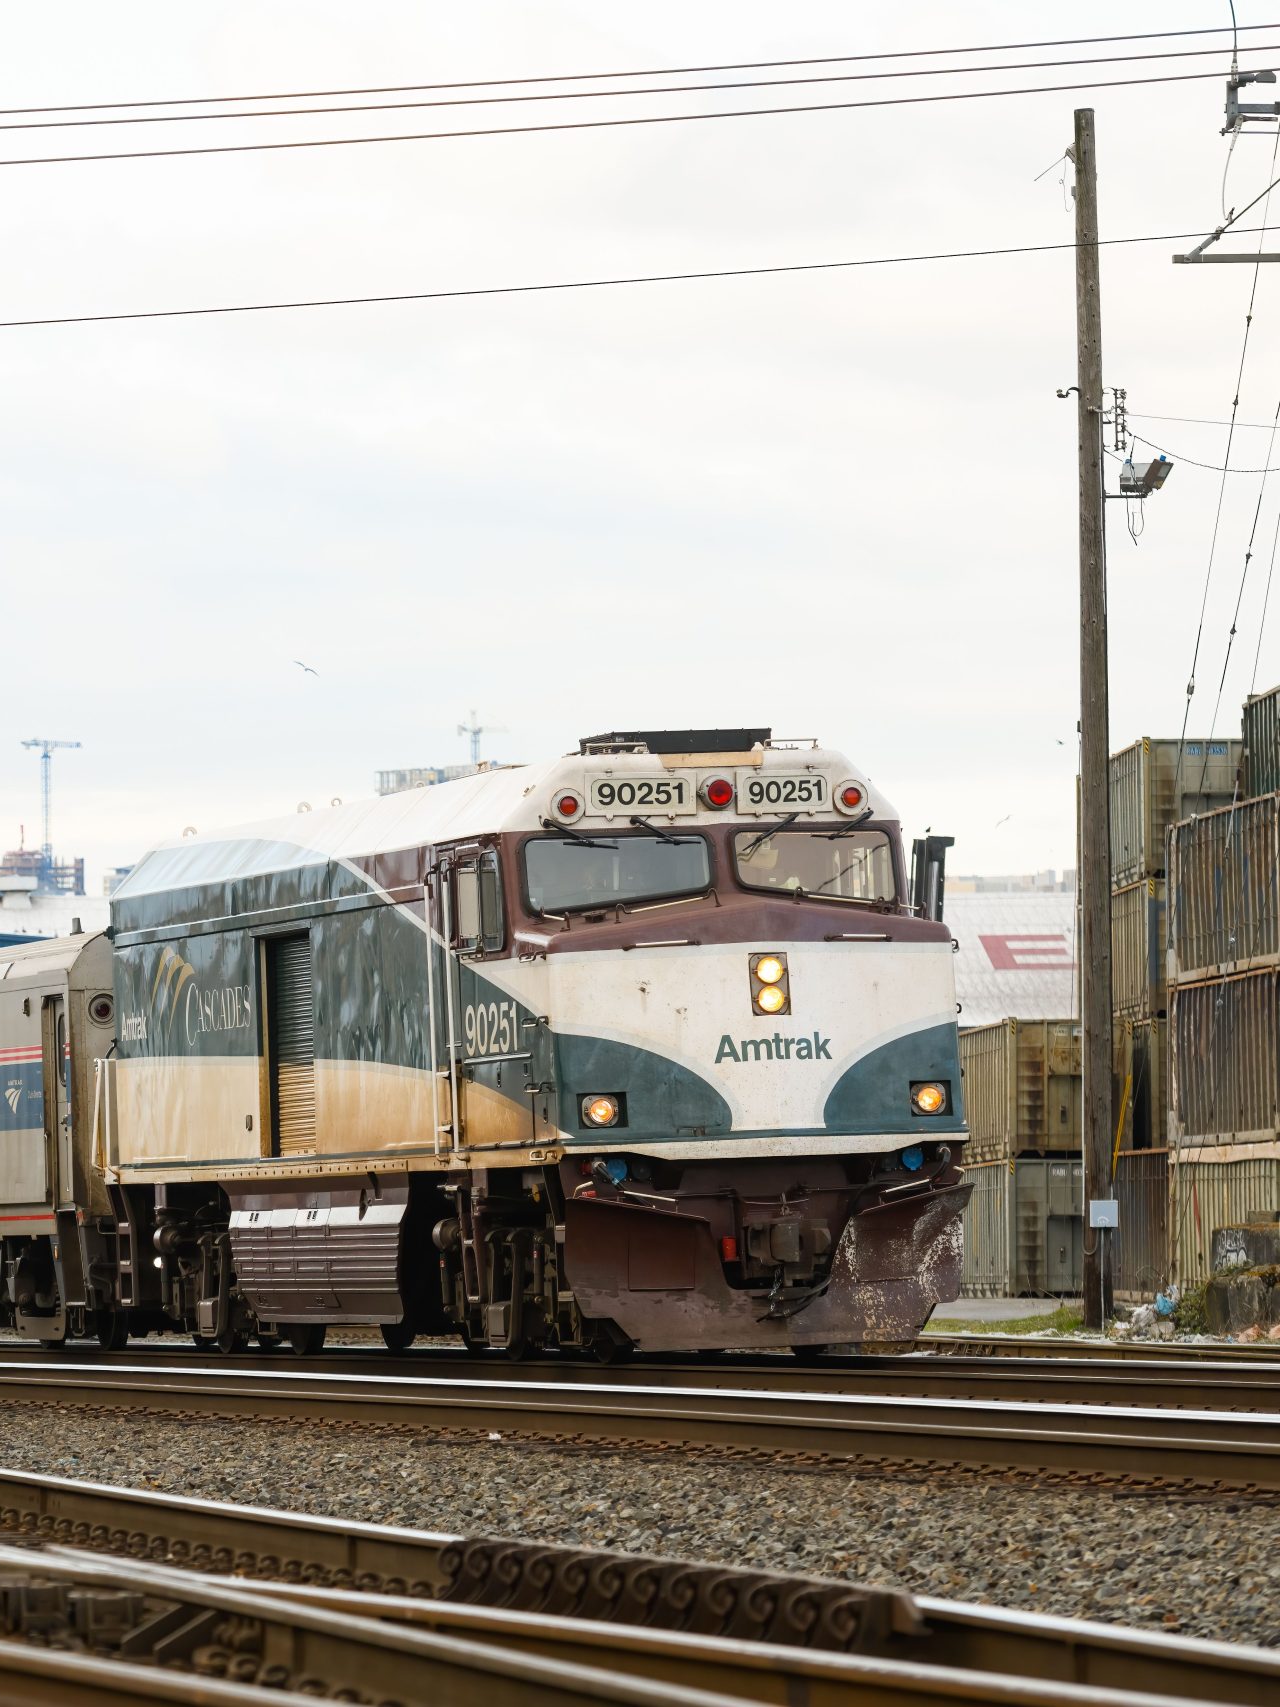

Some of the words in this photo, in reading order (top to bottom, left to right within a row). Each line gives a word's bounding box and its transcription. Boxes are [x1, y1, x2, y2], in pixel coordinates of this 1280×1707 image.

[597, 782, 684, 805] 90251
[748, 779, 823, 805] 90251
[121, 1008, 148, 1042] Amtrak
[185, 982, 251, 1047] CASCADES
[465, 1000, 518, 1057] 90251
[714, 1031, 833, 1064] Amtrak
